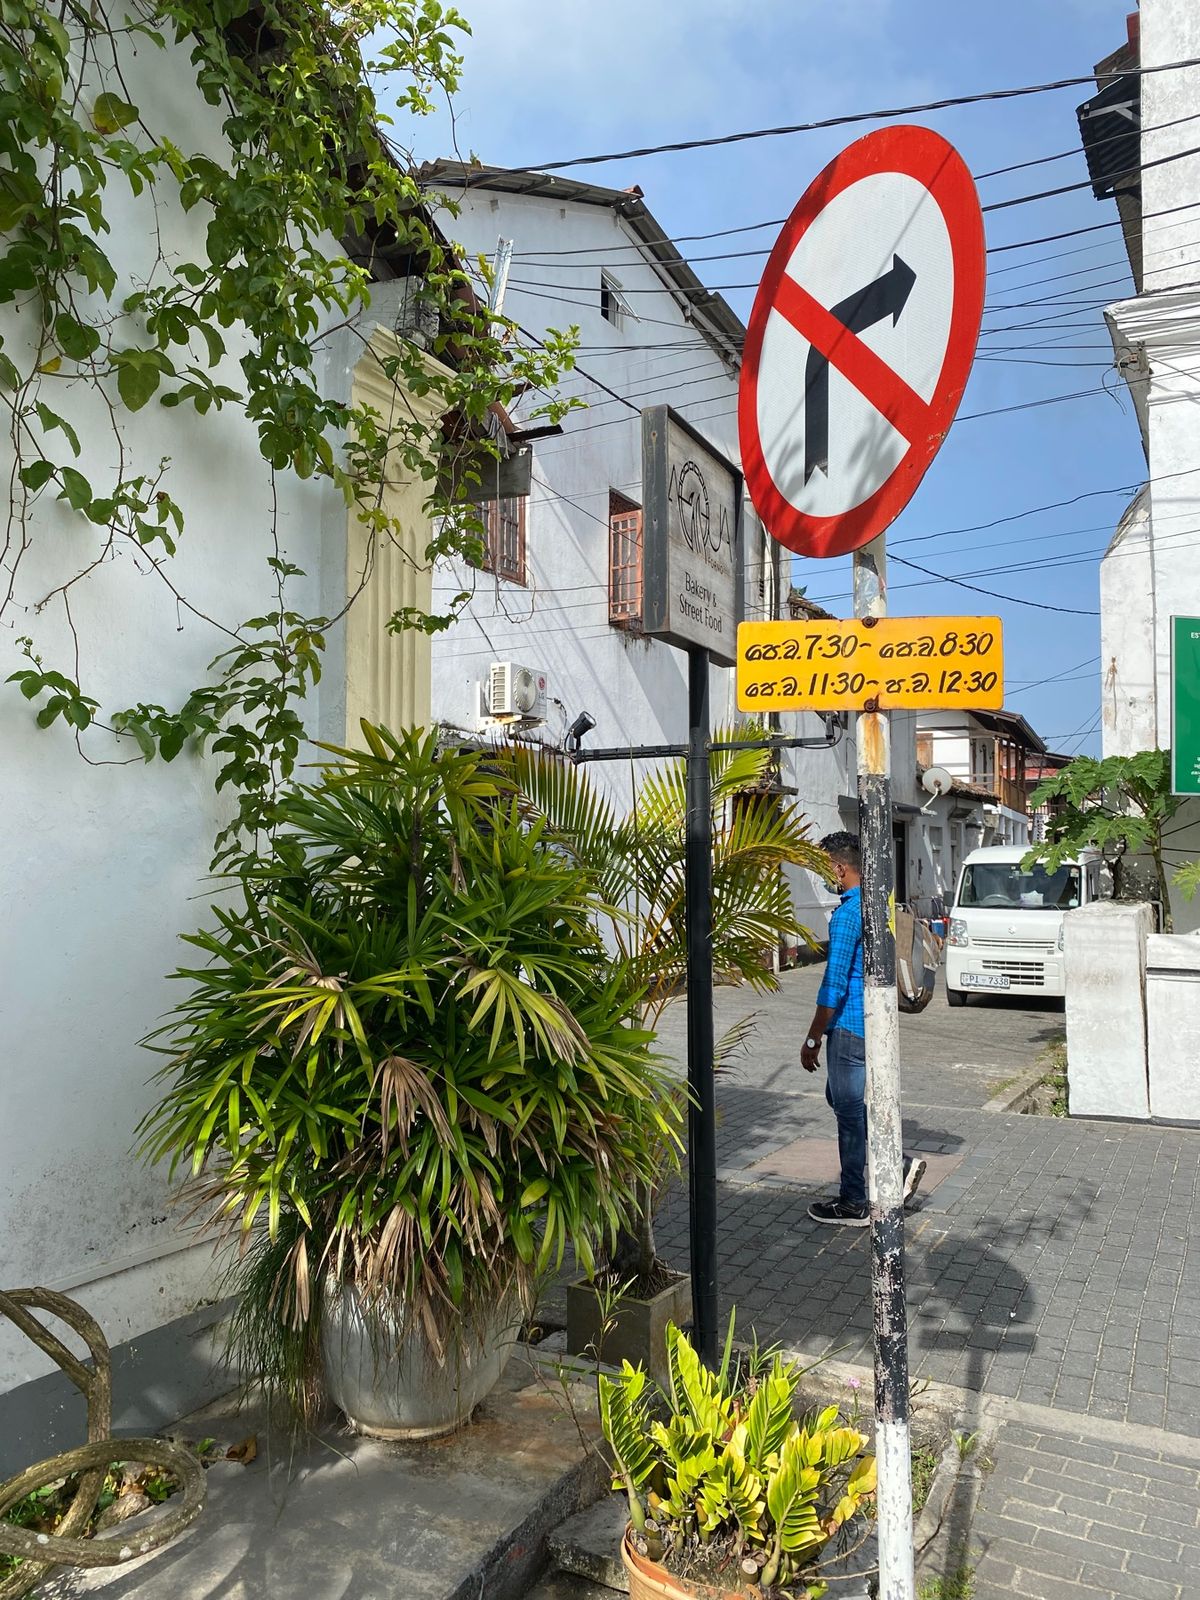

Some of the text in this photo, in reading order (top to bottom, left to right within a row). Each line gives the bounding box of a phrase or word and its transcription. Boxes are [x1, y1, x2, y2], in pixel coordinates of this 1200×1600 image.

[685, 571, 717, 607] Bakery &
[679, 593, 722, 633] Street Food
[988, 976, 1009, 986] 7338
